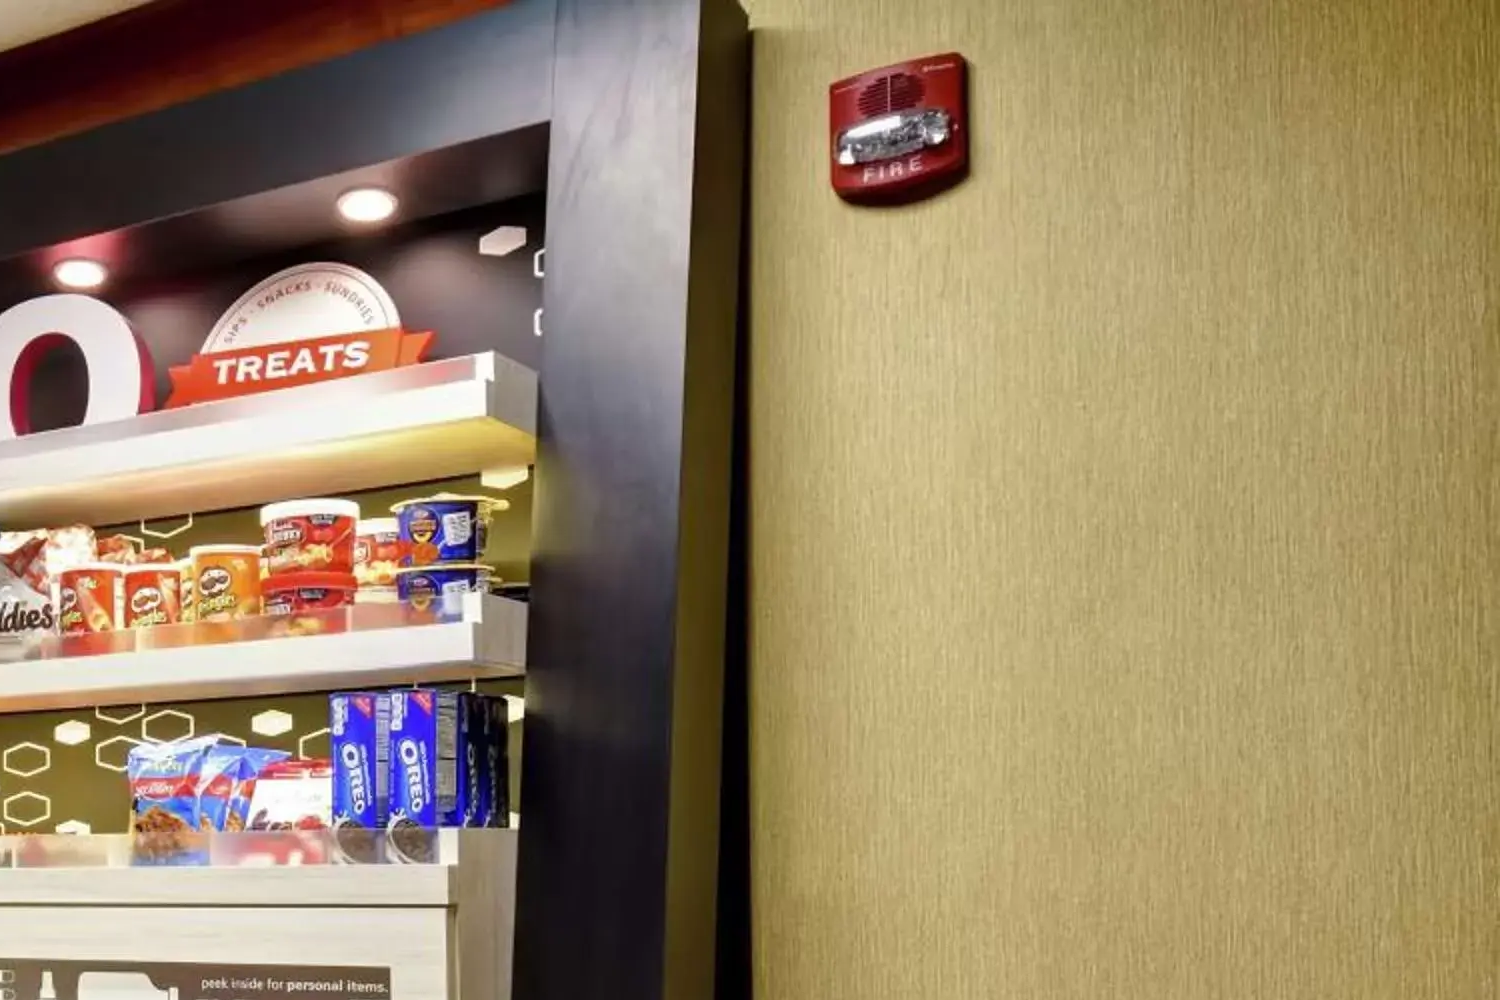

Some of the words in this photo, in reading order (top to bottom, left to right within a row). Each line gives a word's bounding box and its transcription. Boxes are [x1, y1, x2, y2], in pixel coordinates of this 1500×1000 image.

[862, 155, 925, 183] FIRE
[223, 316, 248, 344] SIPS
[256, 280, 313, 309] SNACKS
[323, 281, 376, 326] SUNDRIES
[212, 340, 372, 385] TREATS
[341, 742, 366, 815] OREO
[399, 738, 424, 814] OREO
[200, 977, 228, 991] peek
[231, 977, 263, 989] inside
[267, 978, 285, 990] for
[287, 979, 344, 993] personal
[347, 980, 389, 993] items.
